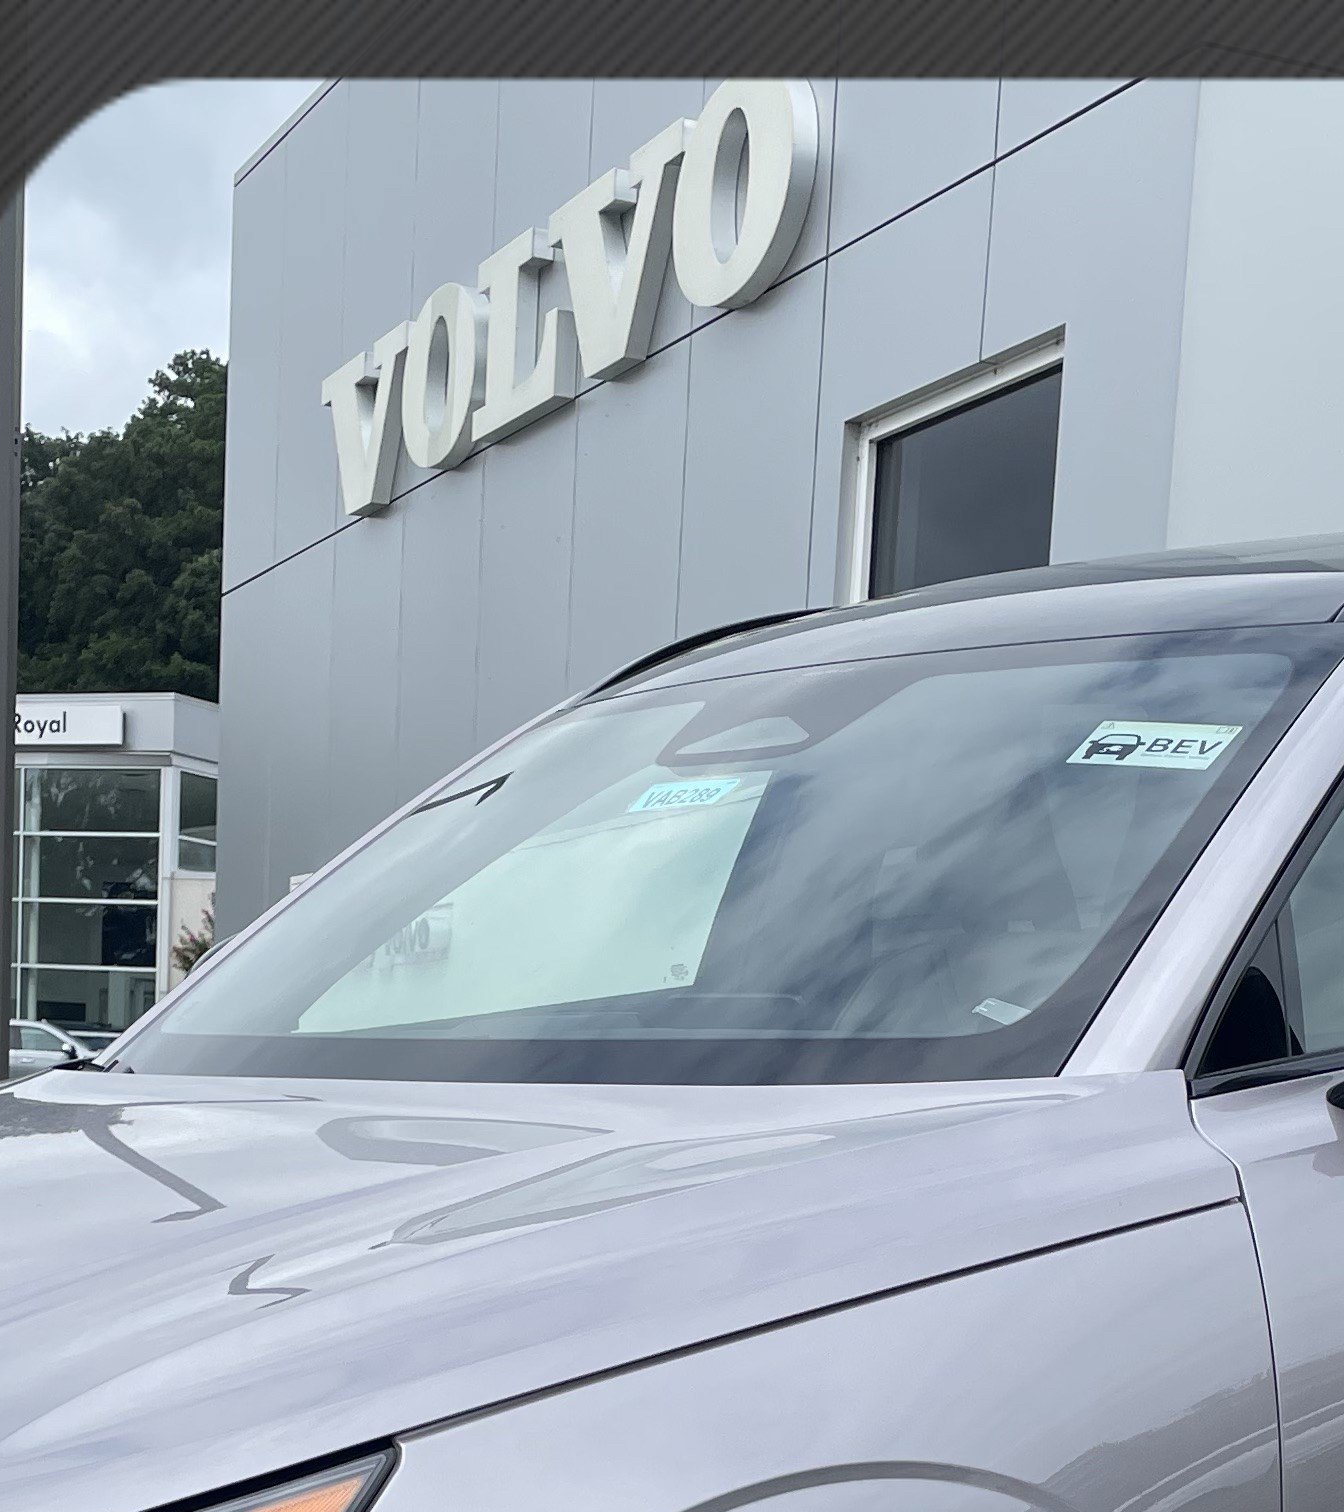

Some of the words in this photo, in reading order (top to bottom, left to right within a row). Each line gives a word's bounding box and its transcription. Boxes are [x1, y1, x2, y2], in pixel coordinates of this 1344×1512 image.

[322, 78, 819, 517] VOLVO
[13, 710, 68, 740] Royal
[1144, 737, 1223, 756] BEV
[641, 786, 723, 809] VAB289
